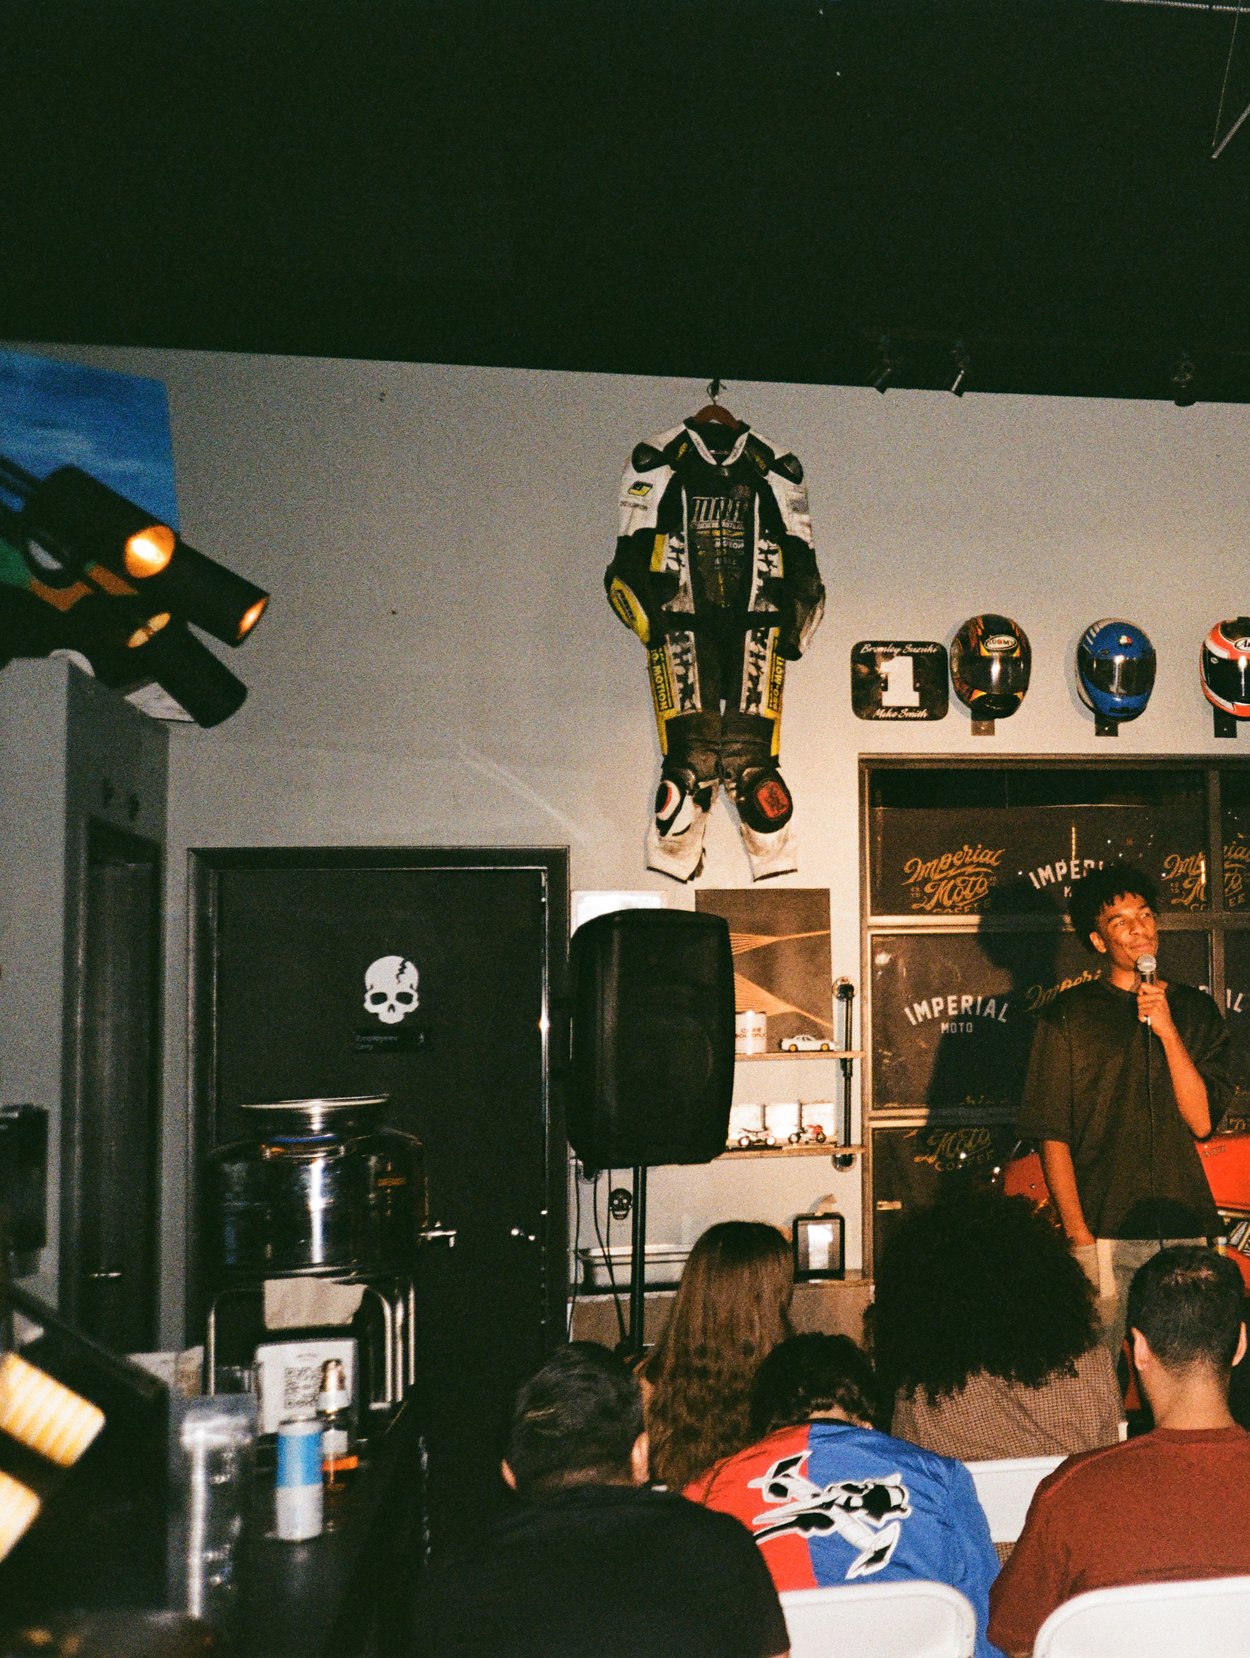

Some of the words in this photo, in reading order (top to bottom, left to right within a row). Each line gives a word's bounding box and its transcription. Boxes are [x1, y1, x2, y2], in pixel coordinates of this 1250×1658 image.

[879, 655, 920, 707] 1
[898, 708, 929, 718] Smith
[901, 844, 1006, 886] Imperial
[1028, 859, 1104, 889] IMPER
[904, 995, 1009, 1026] IMPERIAL
[941, 1022, 973, 1034] MOTO
